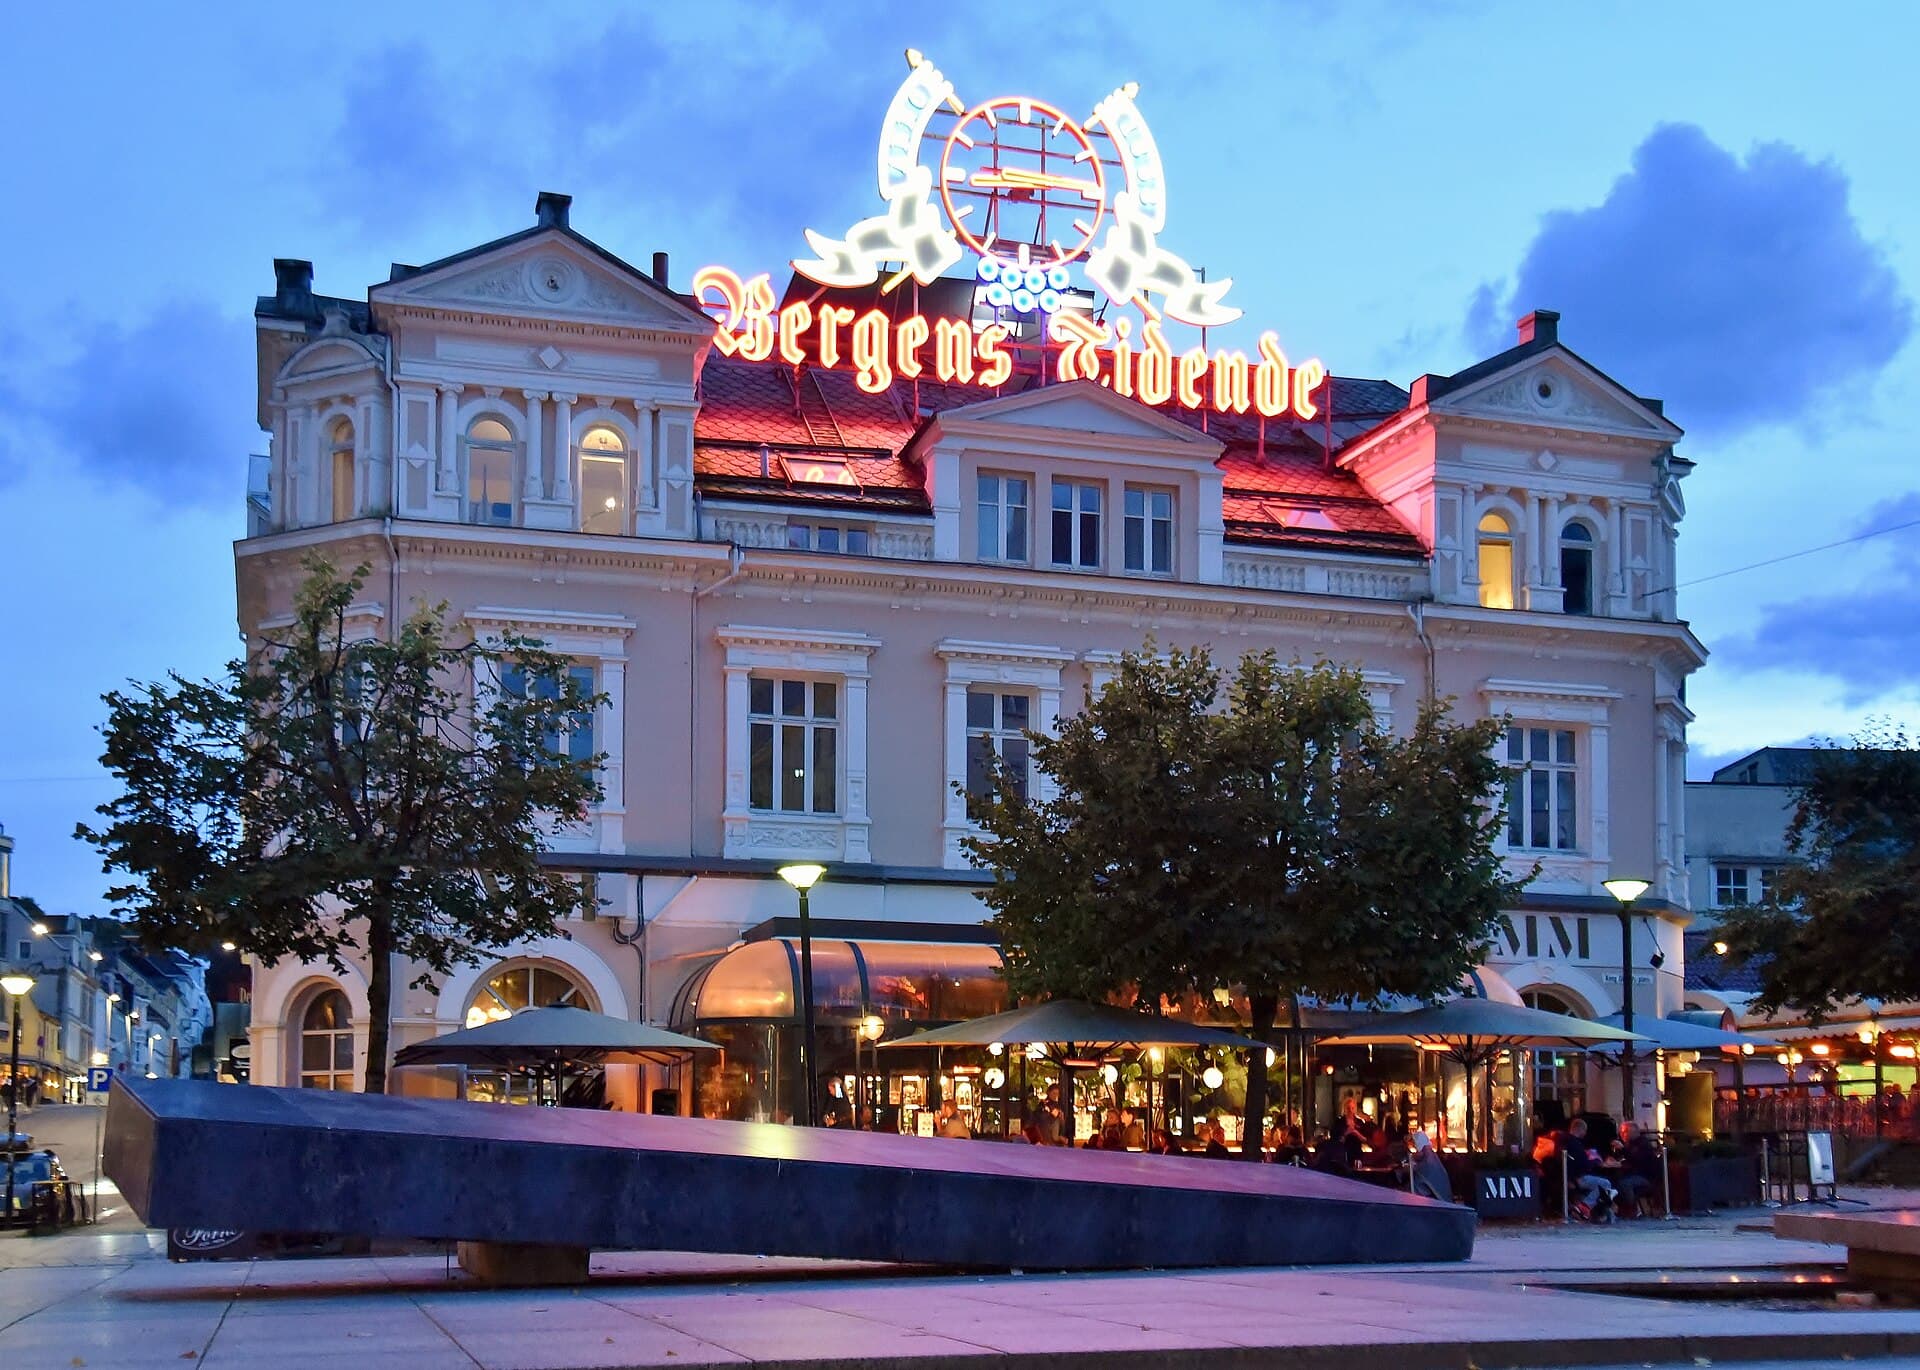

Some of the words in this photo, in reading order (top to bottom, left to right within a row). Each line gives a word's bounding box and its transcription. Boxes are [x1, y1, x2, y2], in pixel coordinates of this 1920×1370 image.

[692, 265, 1013, 393] Bergens
[1049, 309, 1324, 420] Tidende
[92, 1070, 108, 1089] P
[1485, 1176, 1532, 1198] MM
